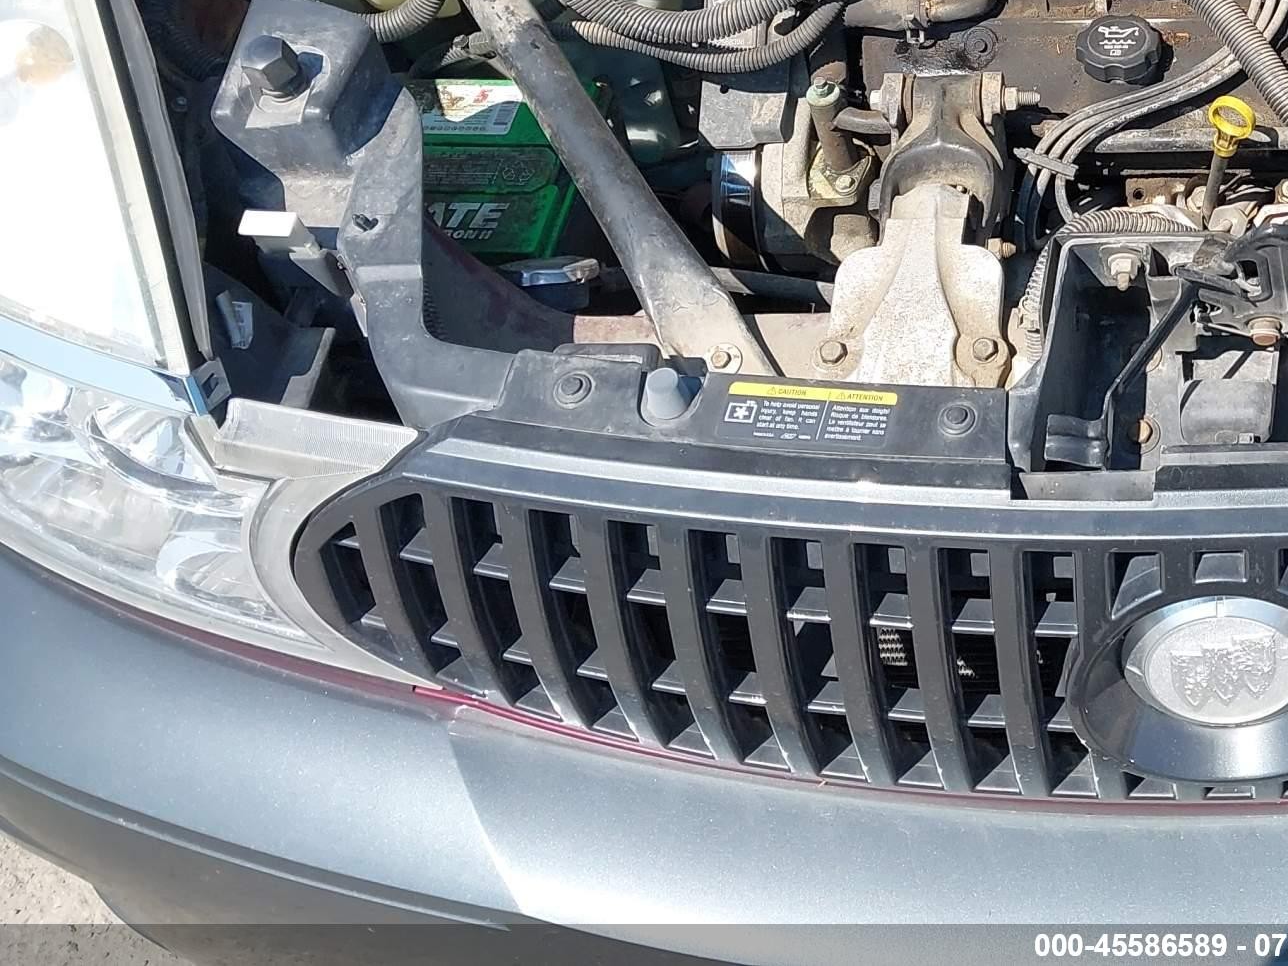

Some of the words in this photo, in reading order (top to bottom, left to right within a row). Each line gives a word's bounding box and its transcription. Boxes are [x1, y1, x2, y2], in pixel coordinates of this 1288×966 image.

[778, 388, 807, 396] CAUTION
[847, 393, 884, 402] ATTENTION
[776, 422, 786, 430] any
